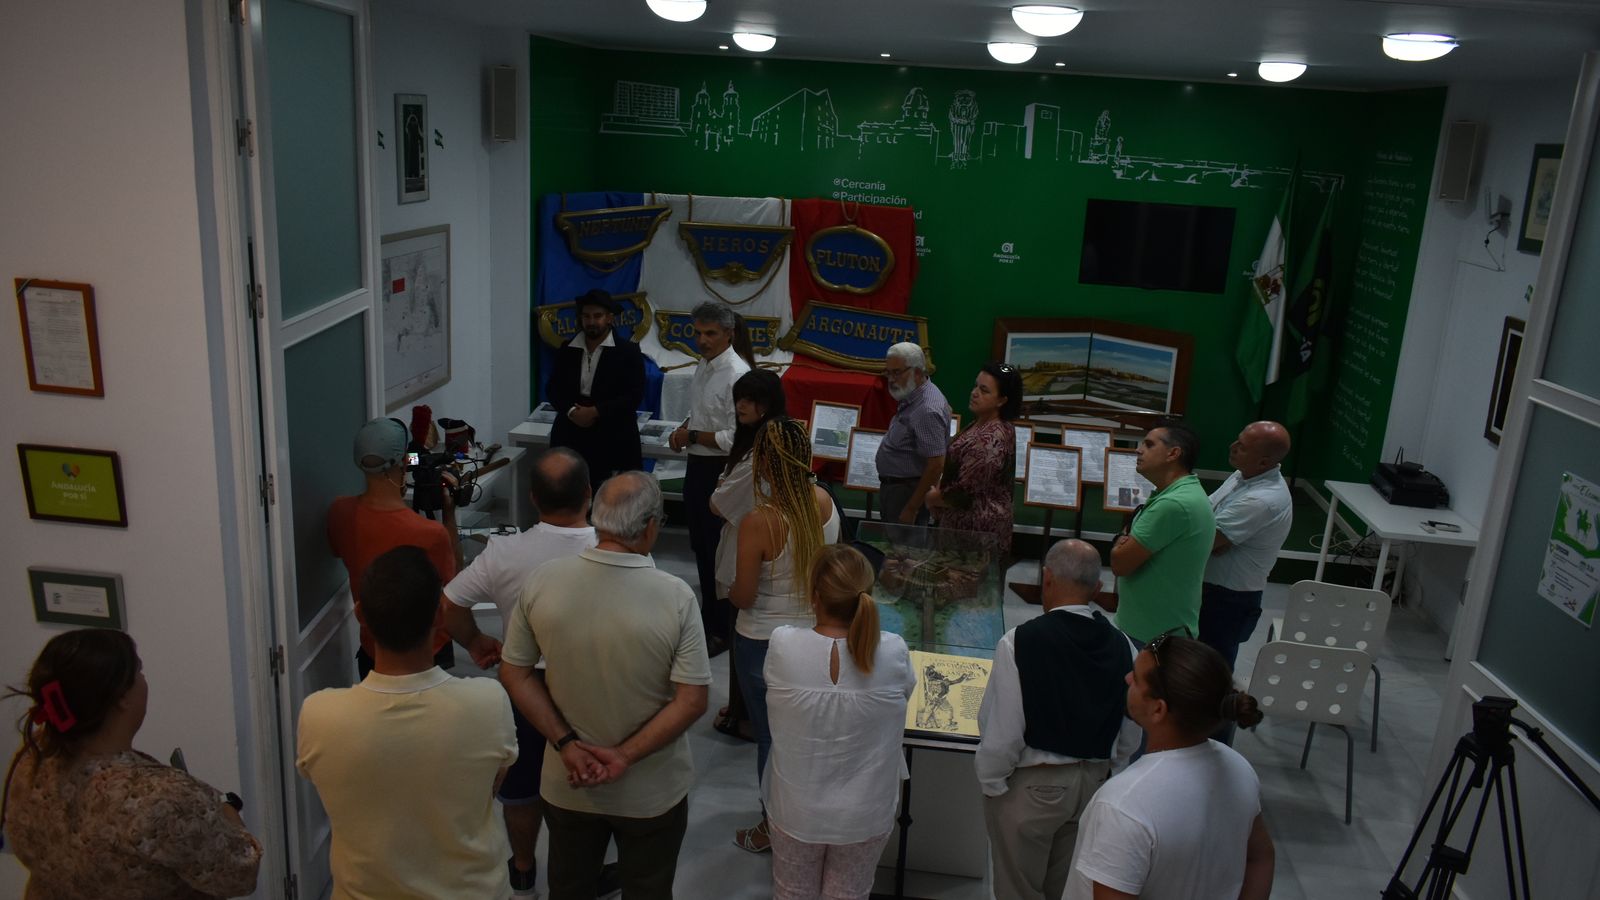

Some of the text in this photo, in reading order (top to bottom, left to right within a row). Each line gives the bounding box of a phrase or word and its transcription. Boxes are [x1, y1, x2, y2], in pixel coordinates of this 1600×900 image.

[841, 178, 886, 191] Cercanía
[840, 191, 907, 204] Participación
[704, 235, 770, 255] HEROS
[816, 248, 881, 272] PLUTON
[807, 314, 915, 344] ARGONAUTE
